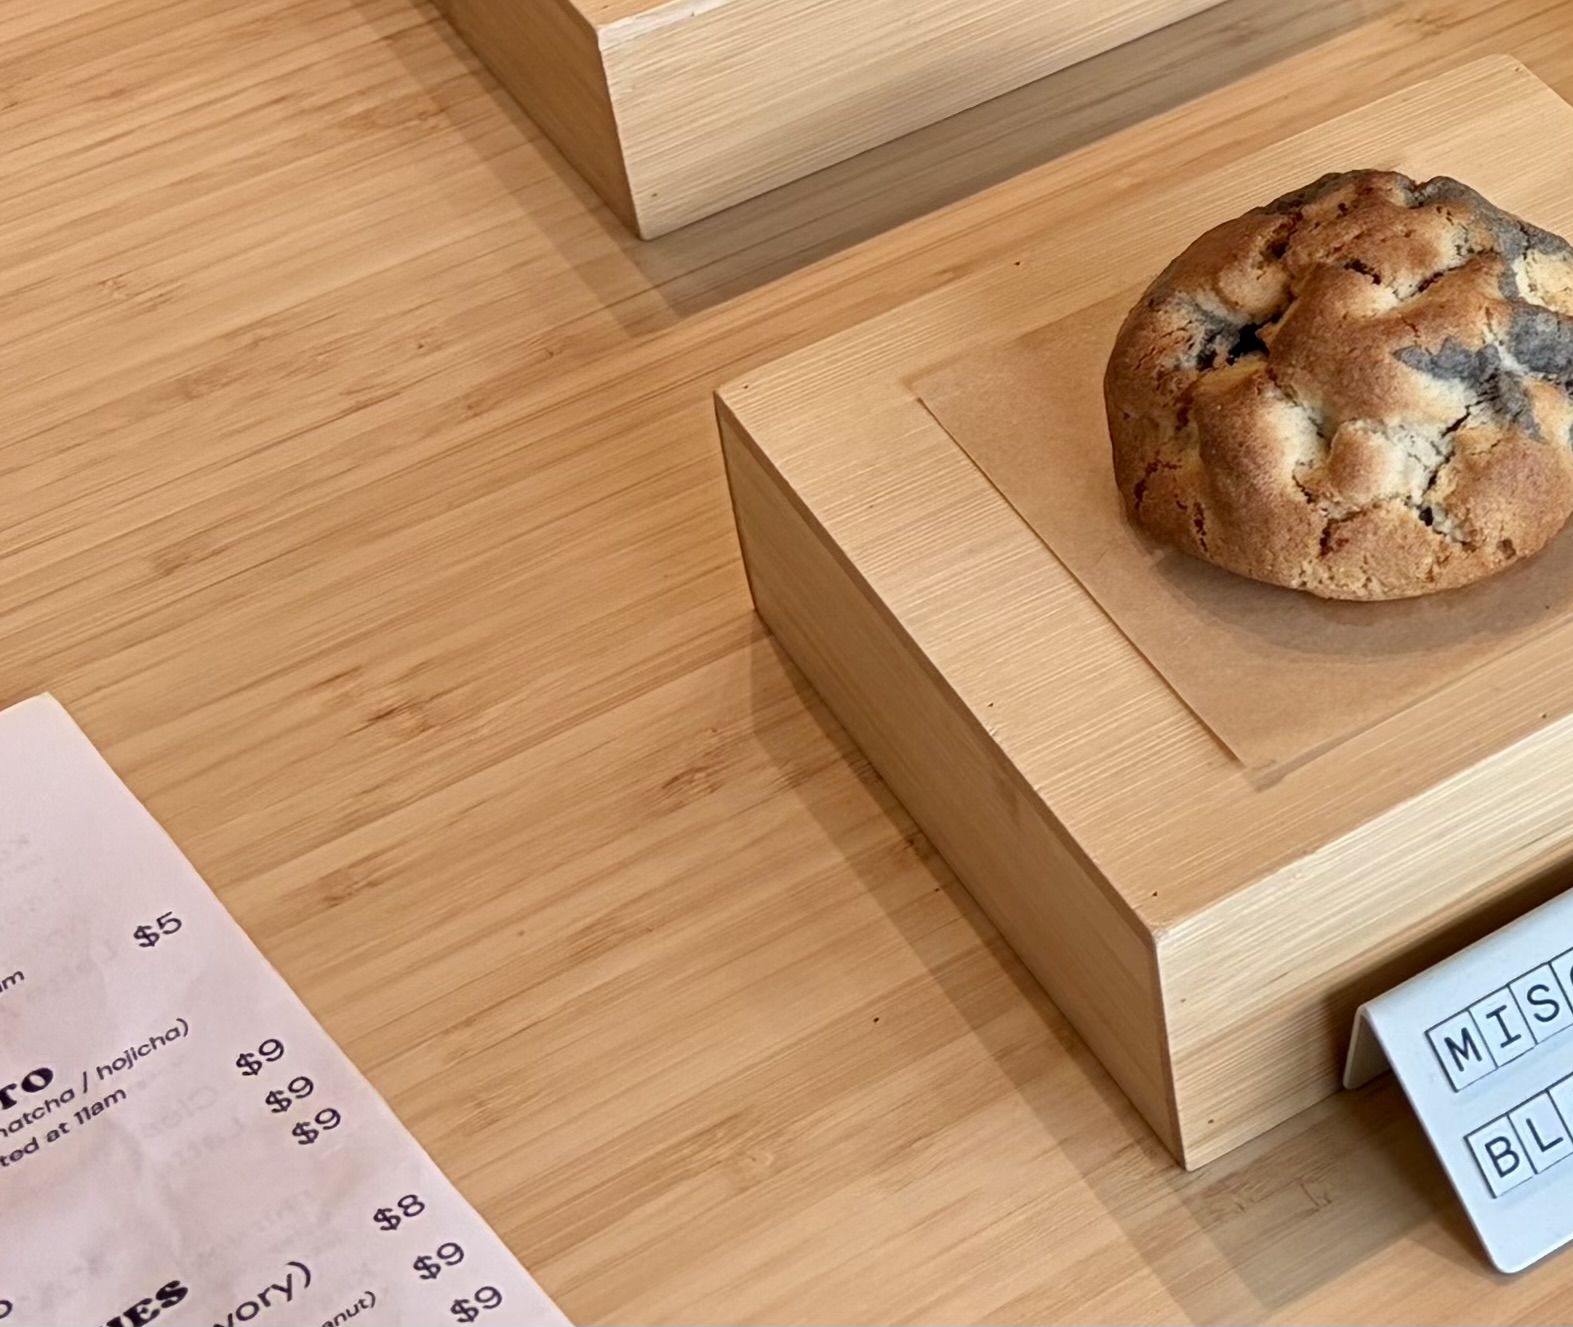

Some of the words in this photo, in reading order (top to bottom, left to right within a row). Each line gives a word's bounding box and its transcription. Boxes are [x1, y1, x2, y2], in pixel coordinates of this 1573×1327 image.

[133, 911, 182, 948] $5
[96, 1017, 189, 1080] hojicha)
[235, 1038, 285, 1076] $9
[265, 1075, 314, 1114] $9
[46, 1122, 70, 1143] at
[74, 1087, 127, 1126] 11am
[292, 1107, 341, 1145] $9
[373, 1193, 425, 1232] $8
[413, 1241, 465, 1280] $9
[450, 1285, 503, 1324] $9
